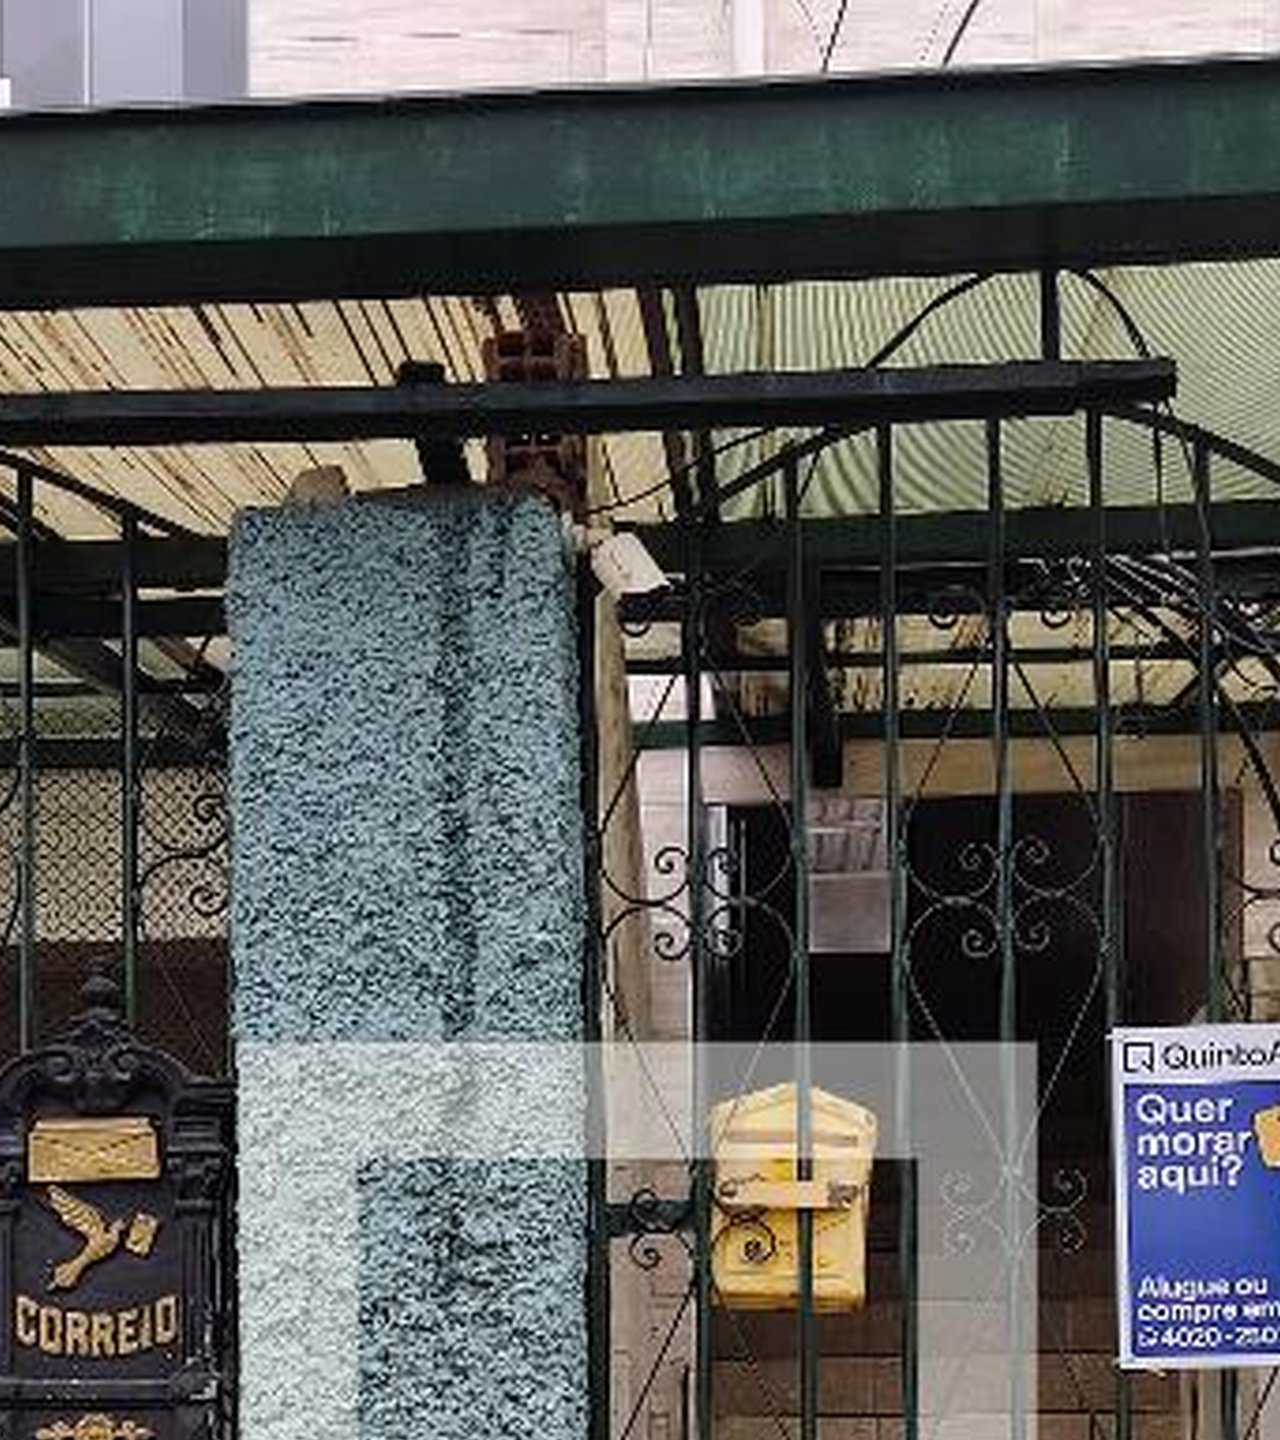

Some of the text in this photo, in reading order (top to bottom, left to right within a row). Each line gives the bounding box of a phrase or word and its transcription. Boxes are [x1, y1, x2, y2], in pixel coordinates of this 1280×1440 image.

[1137, 1093, 1233, 1125] Quer
[1137, 1132, 1252, 1156] morar
[1137, 1156, 1243, 1192] aqui?
[1138, 1275, 1268, 1302] Alugue ou
[16, 1296, 178, 1357] CORREIO
[1138, 1304, 1237, 1324] compre
